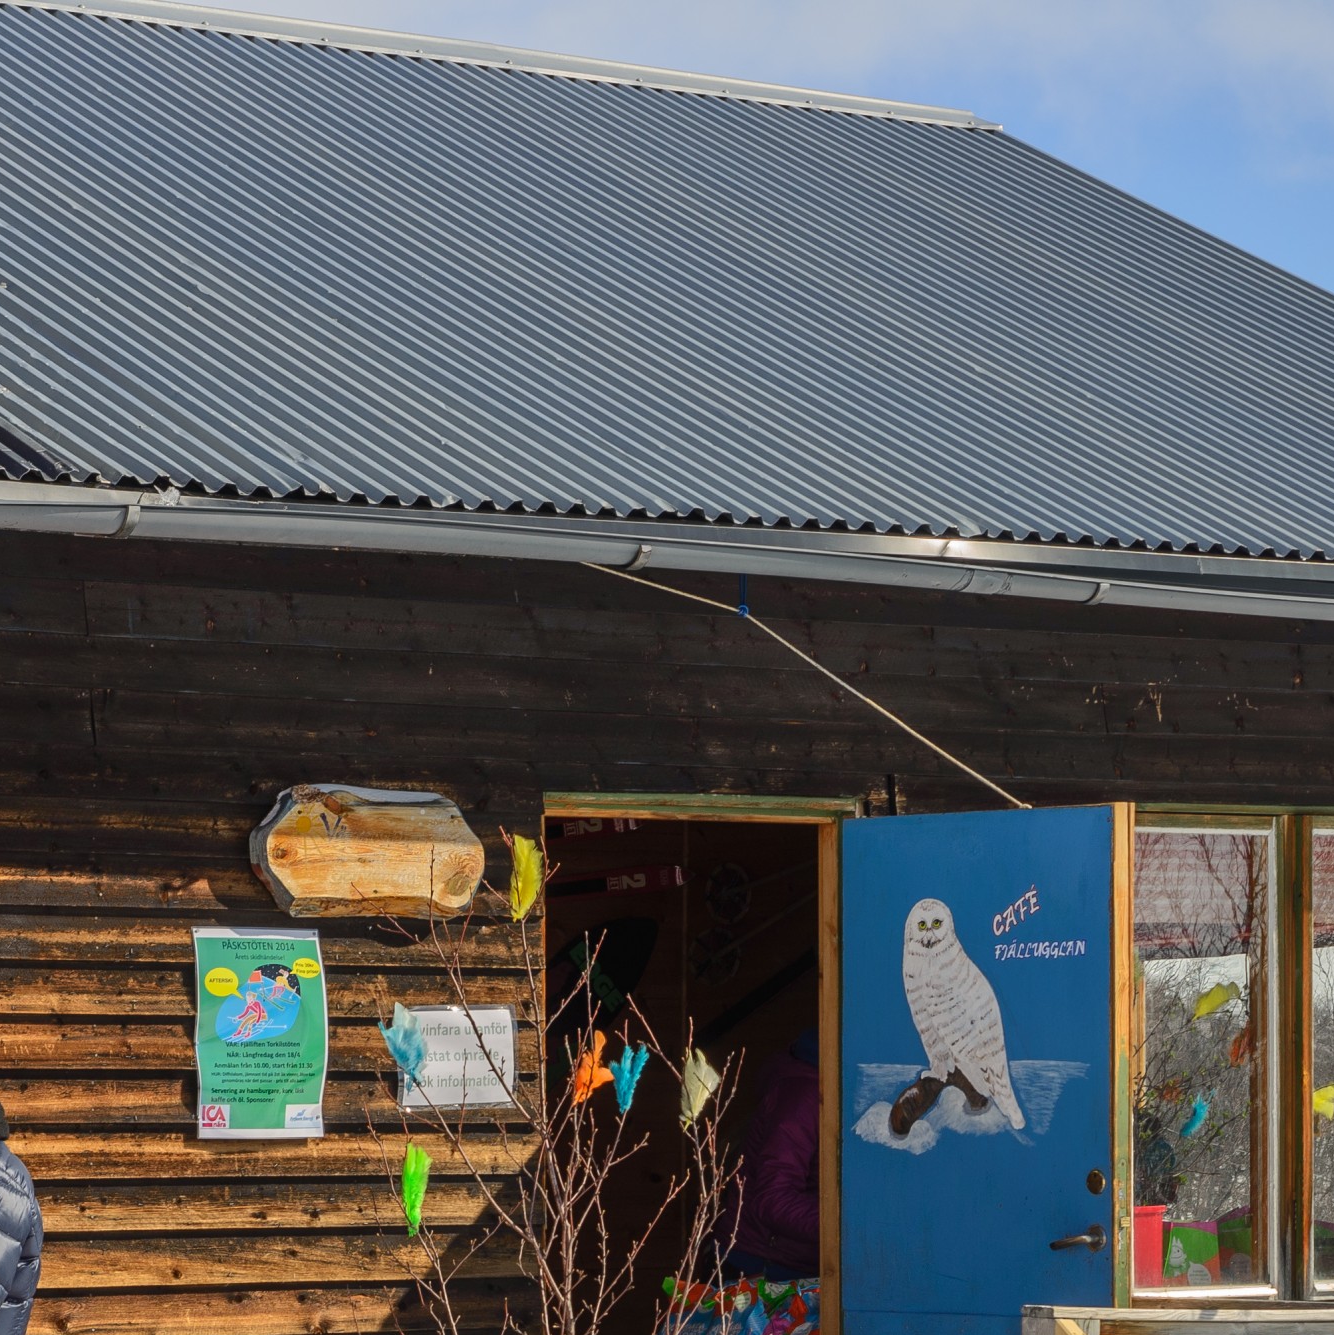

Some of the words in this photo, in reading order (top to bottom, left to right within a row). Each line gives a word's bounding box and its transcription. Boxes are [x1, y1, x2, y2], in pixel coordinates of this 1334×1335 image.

[992, 884, 1040, 936] CAFÉ
[222, 939, 273, 950] PÅSKSTÖTEN
[276, 942, 295, 951] 2014
[994, 939, 1086, 961] FJÄLLUGGLAN
[465, 1022, 507, 1036] uanför
[211, 1087, 237, 1095] Servering
[202, 1105, 226, 1121] ICA
